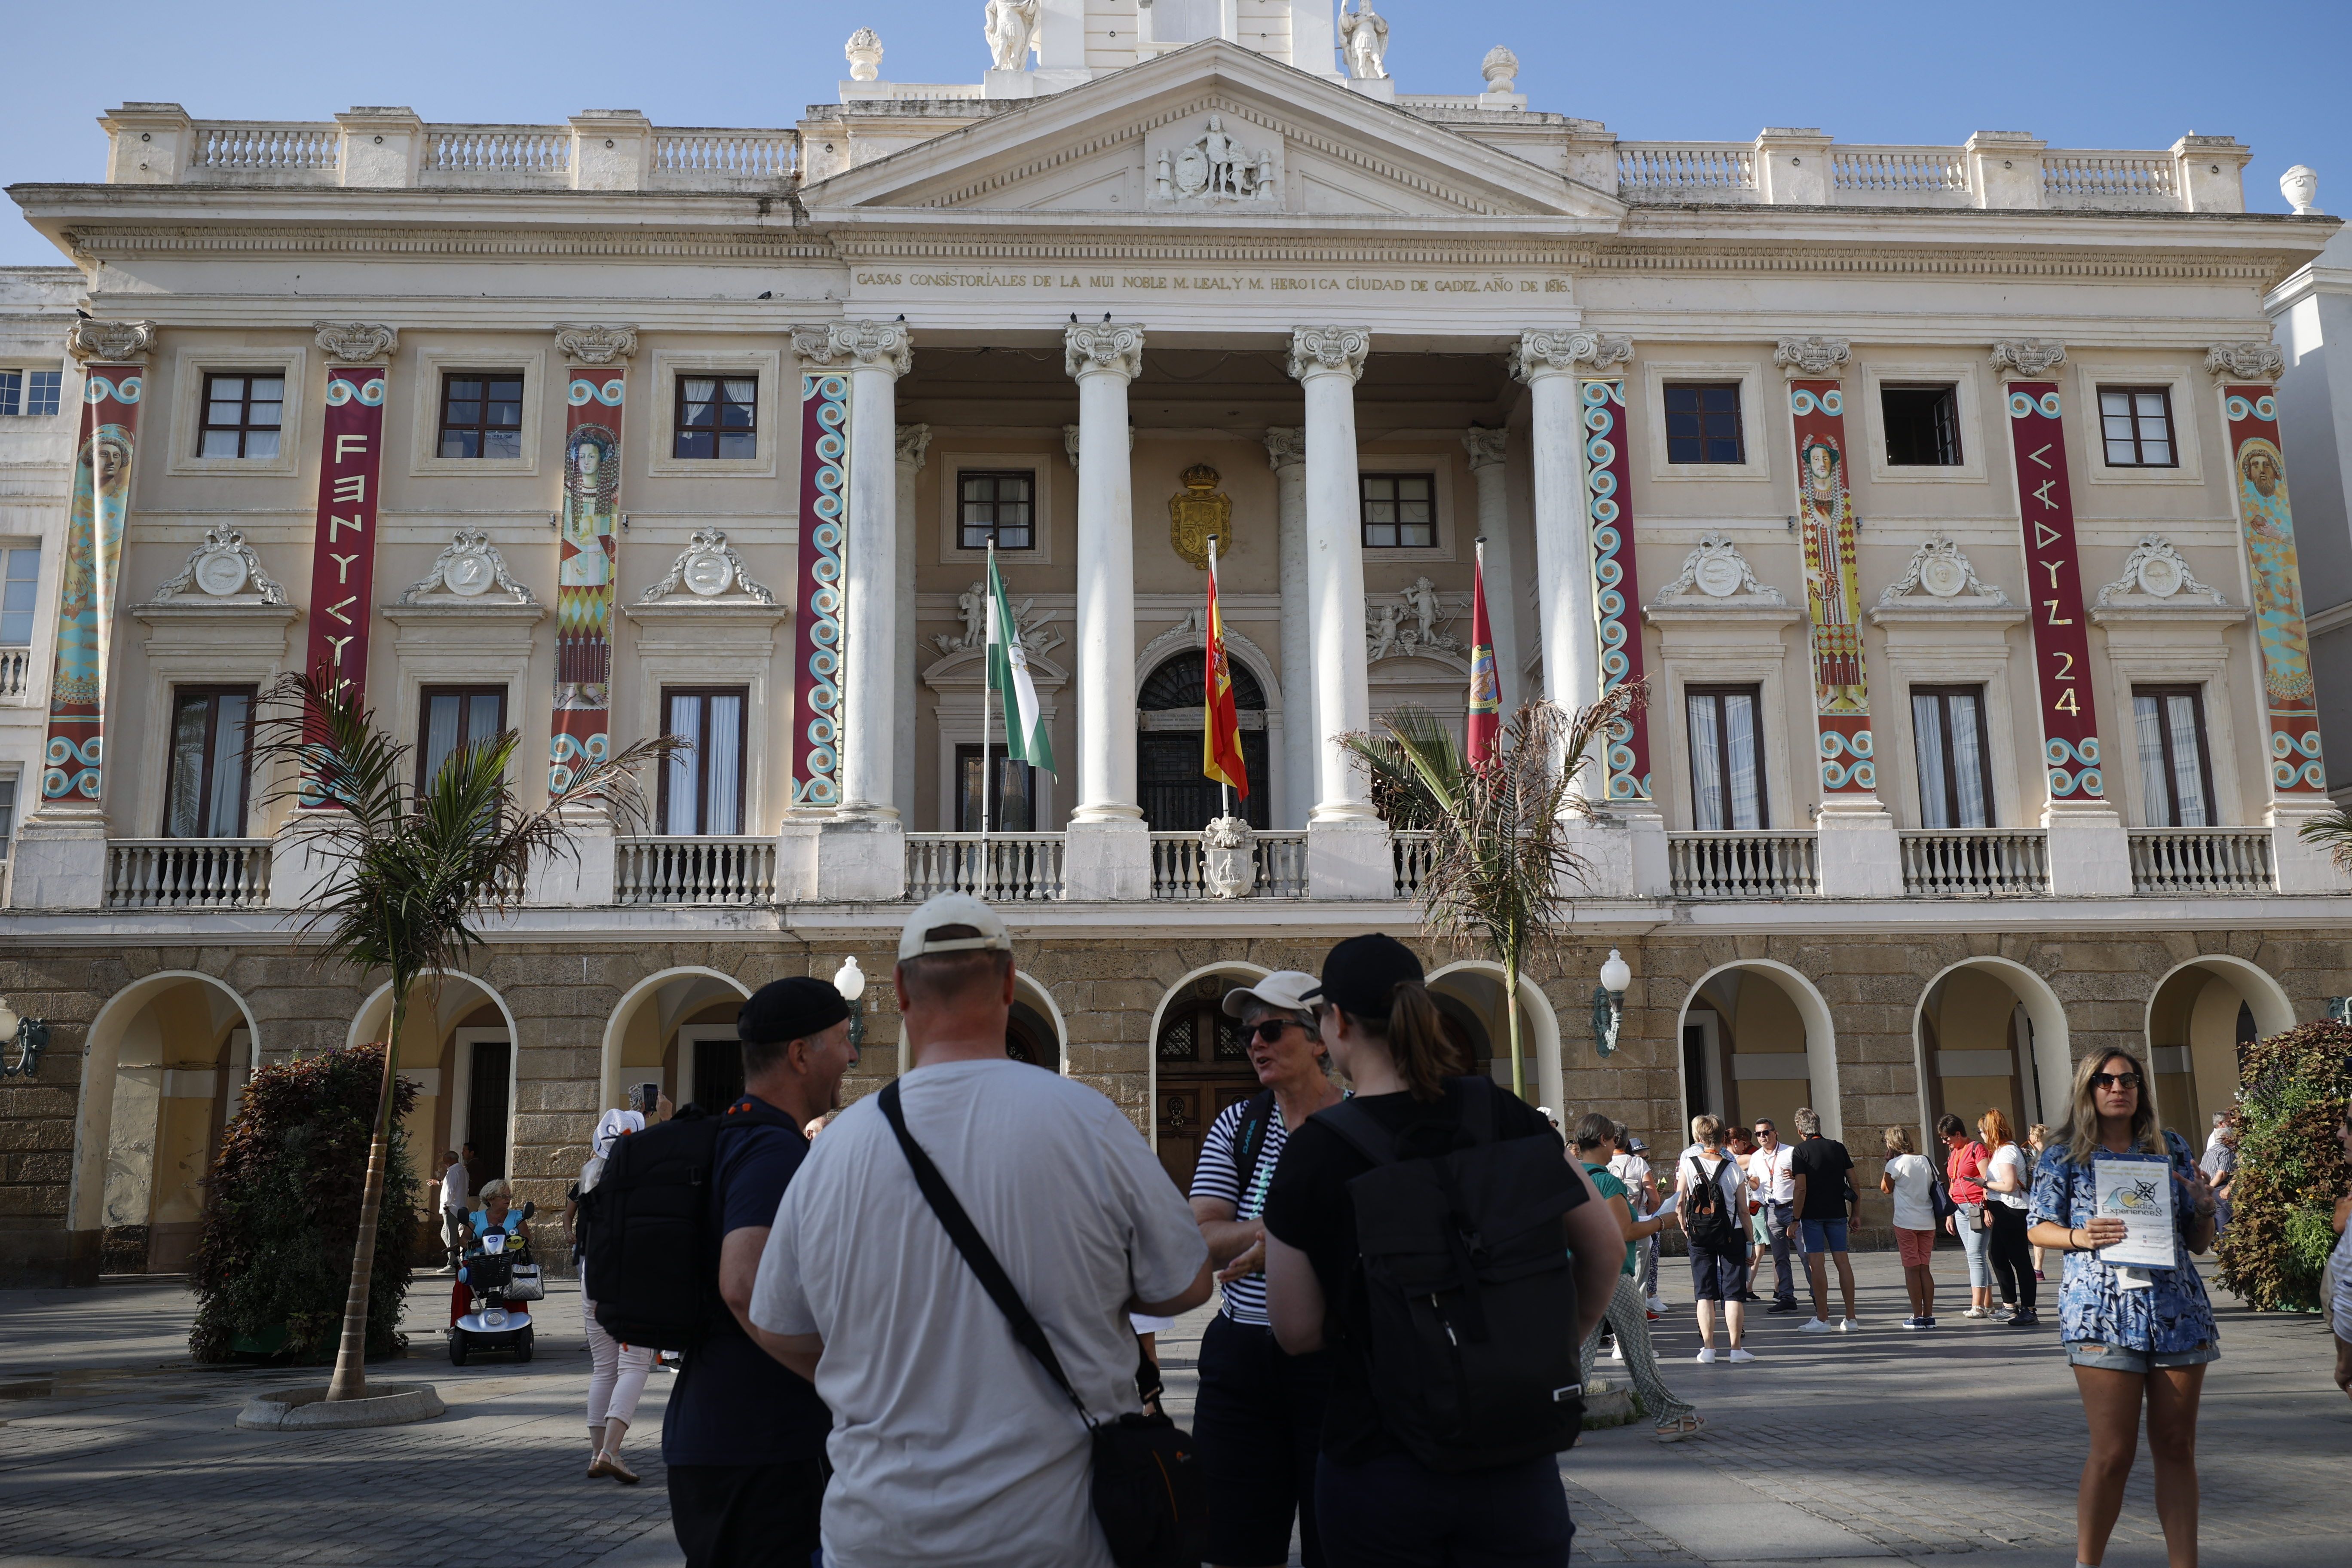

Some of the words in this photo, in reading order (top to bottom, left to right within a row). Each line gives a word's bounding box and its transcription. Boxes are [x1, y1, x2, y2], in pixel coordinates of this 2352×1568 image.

[857, 273, 902, 285] CASAS
[1033, 275, 1051, 287] DE
[1060, 276, 1081, 287] LA
[1090, 276, 1114, 288] MUI
[1123, 276, 1166, 288] NOBLE
[1174, 277, 1189, 288] M.
[1249, 278, 1264, 289] M.
[1346, 276, 1405, 291] CIUDAD
[1411, 280, 1428, 291] DE
[1483, 277, 1513, 292] AÑO
[1520, 281, 1538, 292] DE
[2052, 652, 2081, 717] 24
[1470, 699, 1496, 707] FUNDATO
